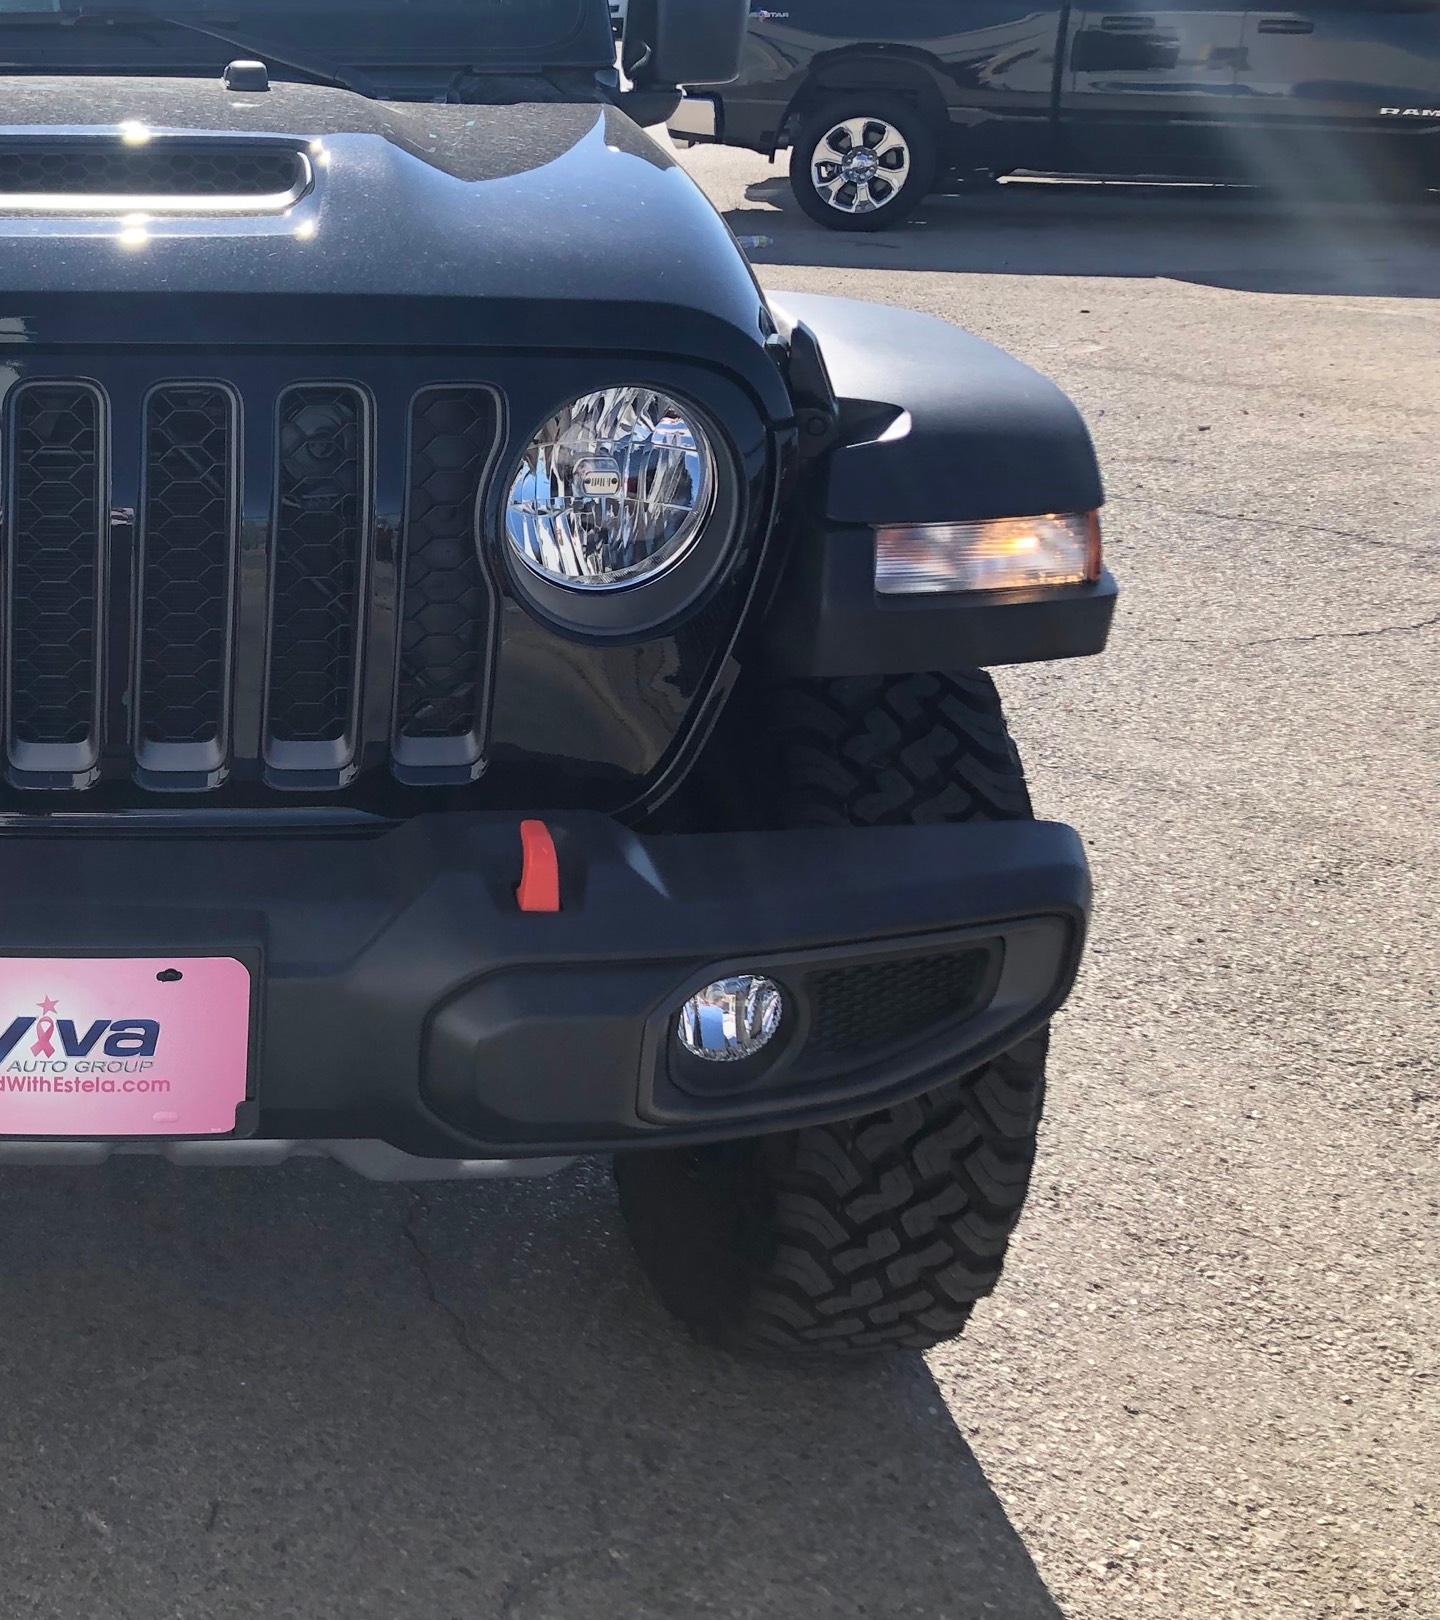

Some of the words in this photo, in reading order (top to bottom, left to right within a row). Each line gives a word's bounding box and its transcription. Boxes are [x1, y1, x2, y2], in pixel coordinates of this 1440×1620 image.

[1379, 107, 1440, 117] RAM
[6, 1060, 68, 1073] AUTO
[74, 1060, 154, 1073] GROUP
